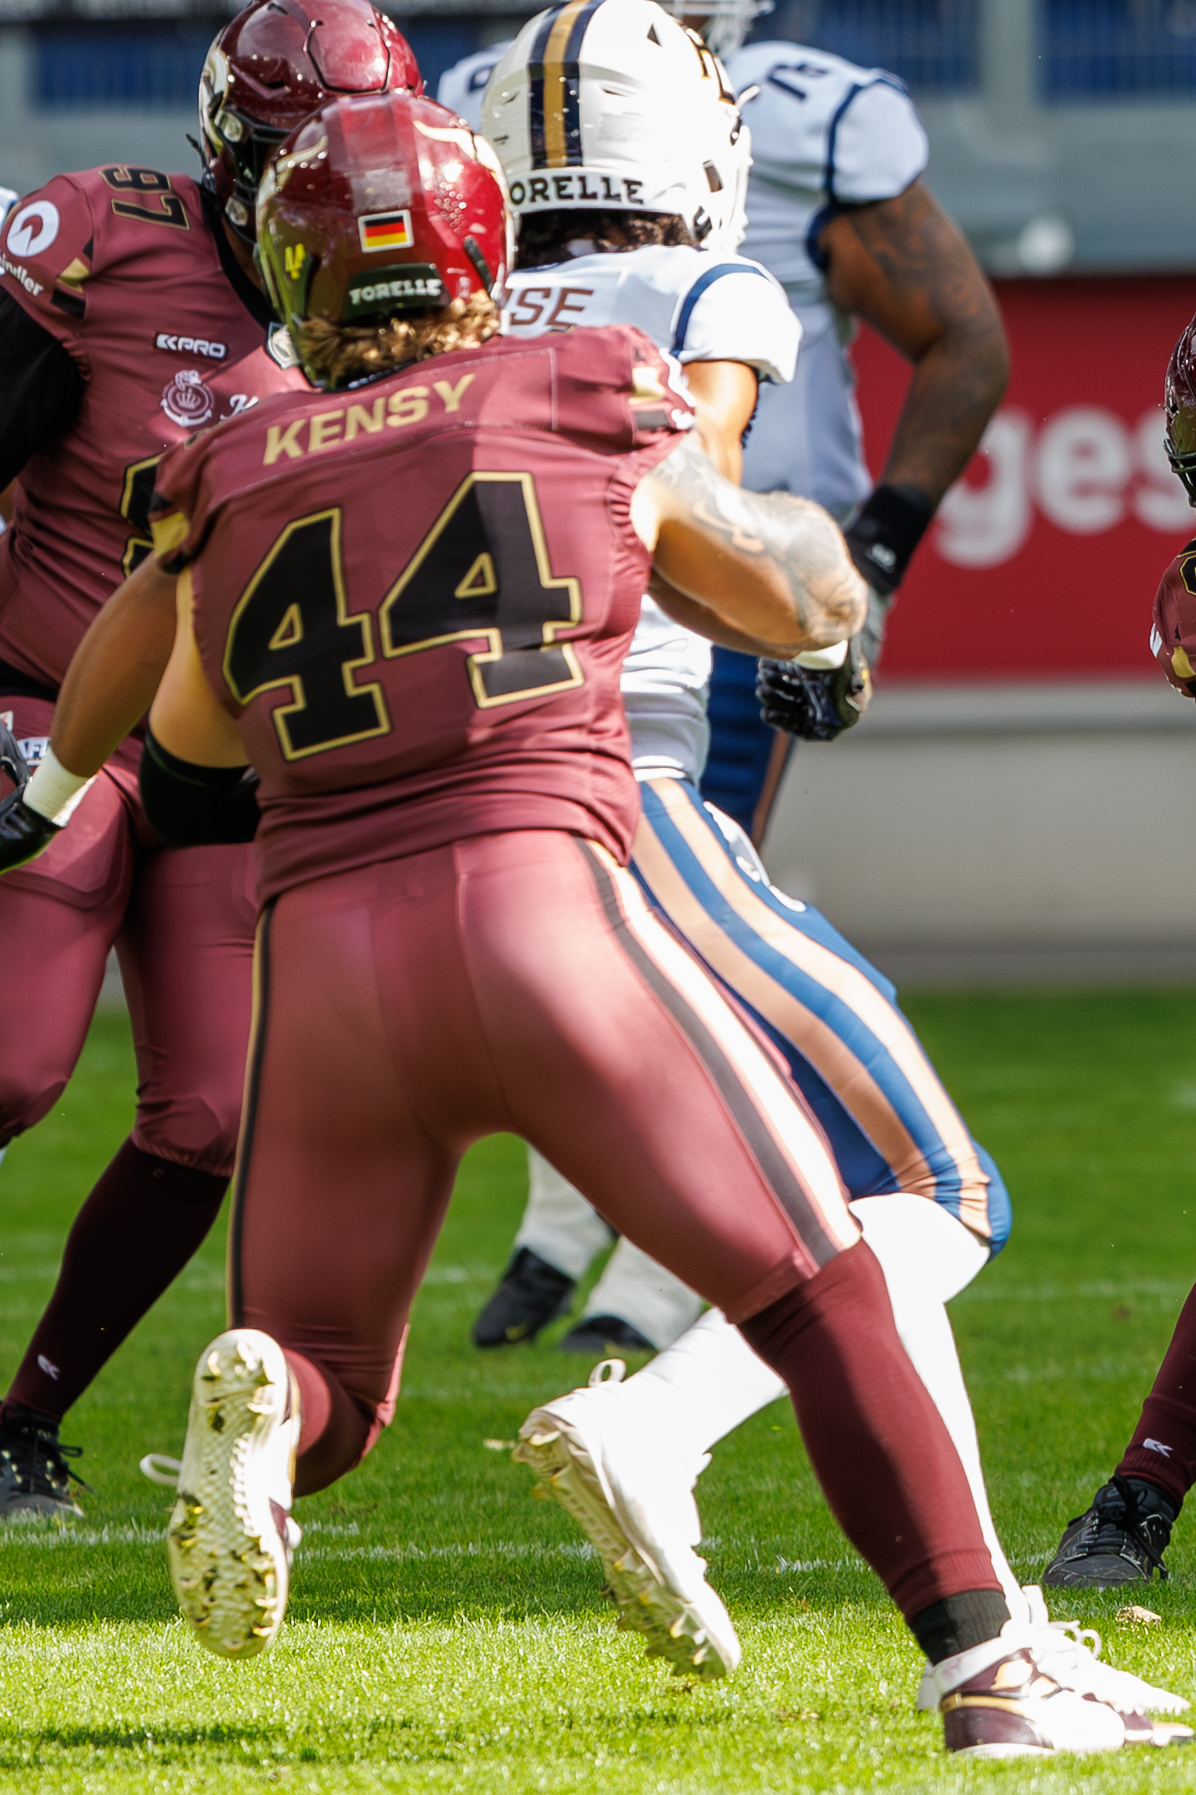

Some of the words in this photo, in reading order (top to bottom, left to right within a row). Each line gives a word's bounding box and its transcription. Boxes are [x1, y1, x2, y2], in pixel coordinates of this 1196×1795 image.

[99, 165, 191, 231] 97
[509, 174, 644, 206] ORELLE
[262, 373, 476, 466] KENSY
[223, 471, 586, 761] 44
